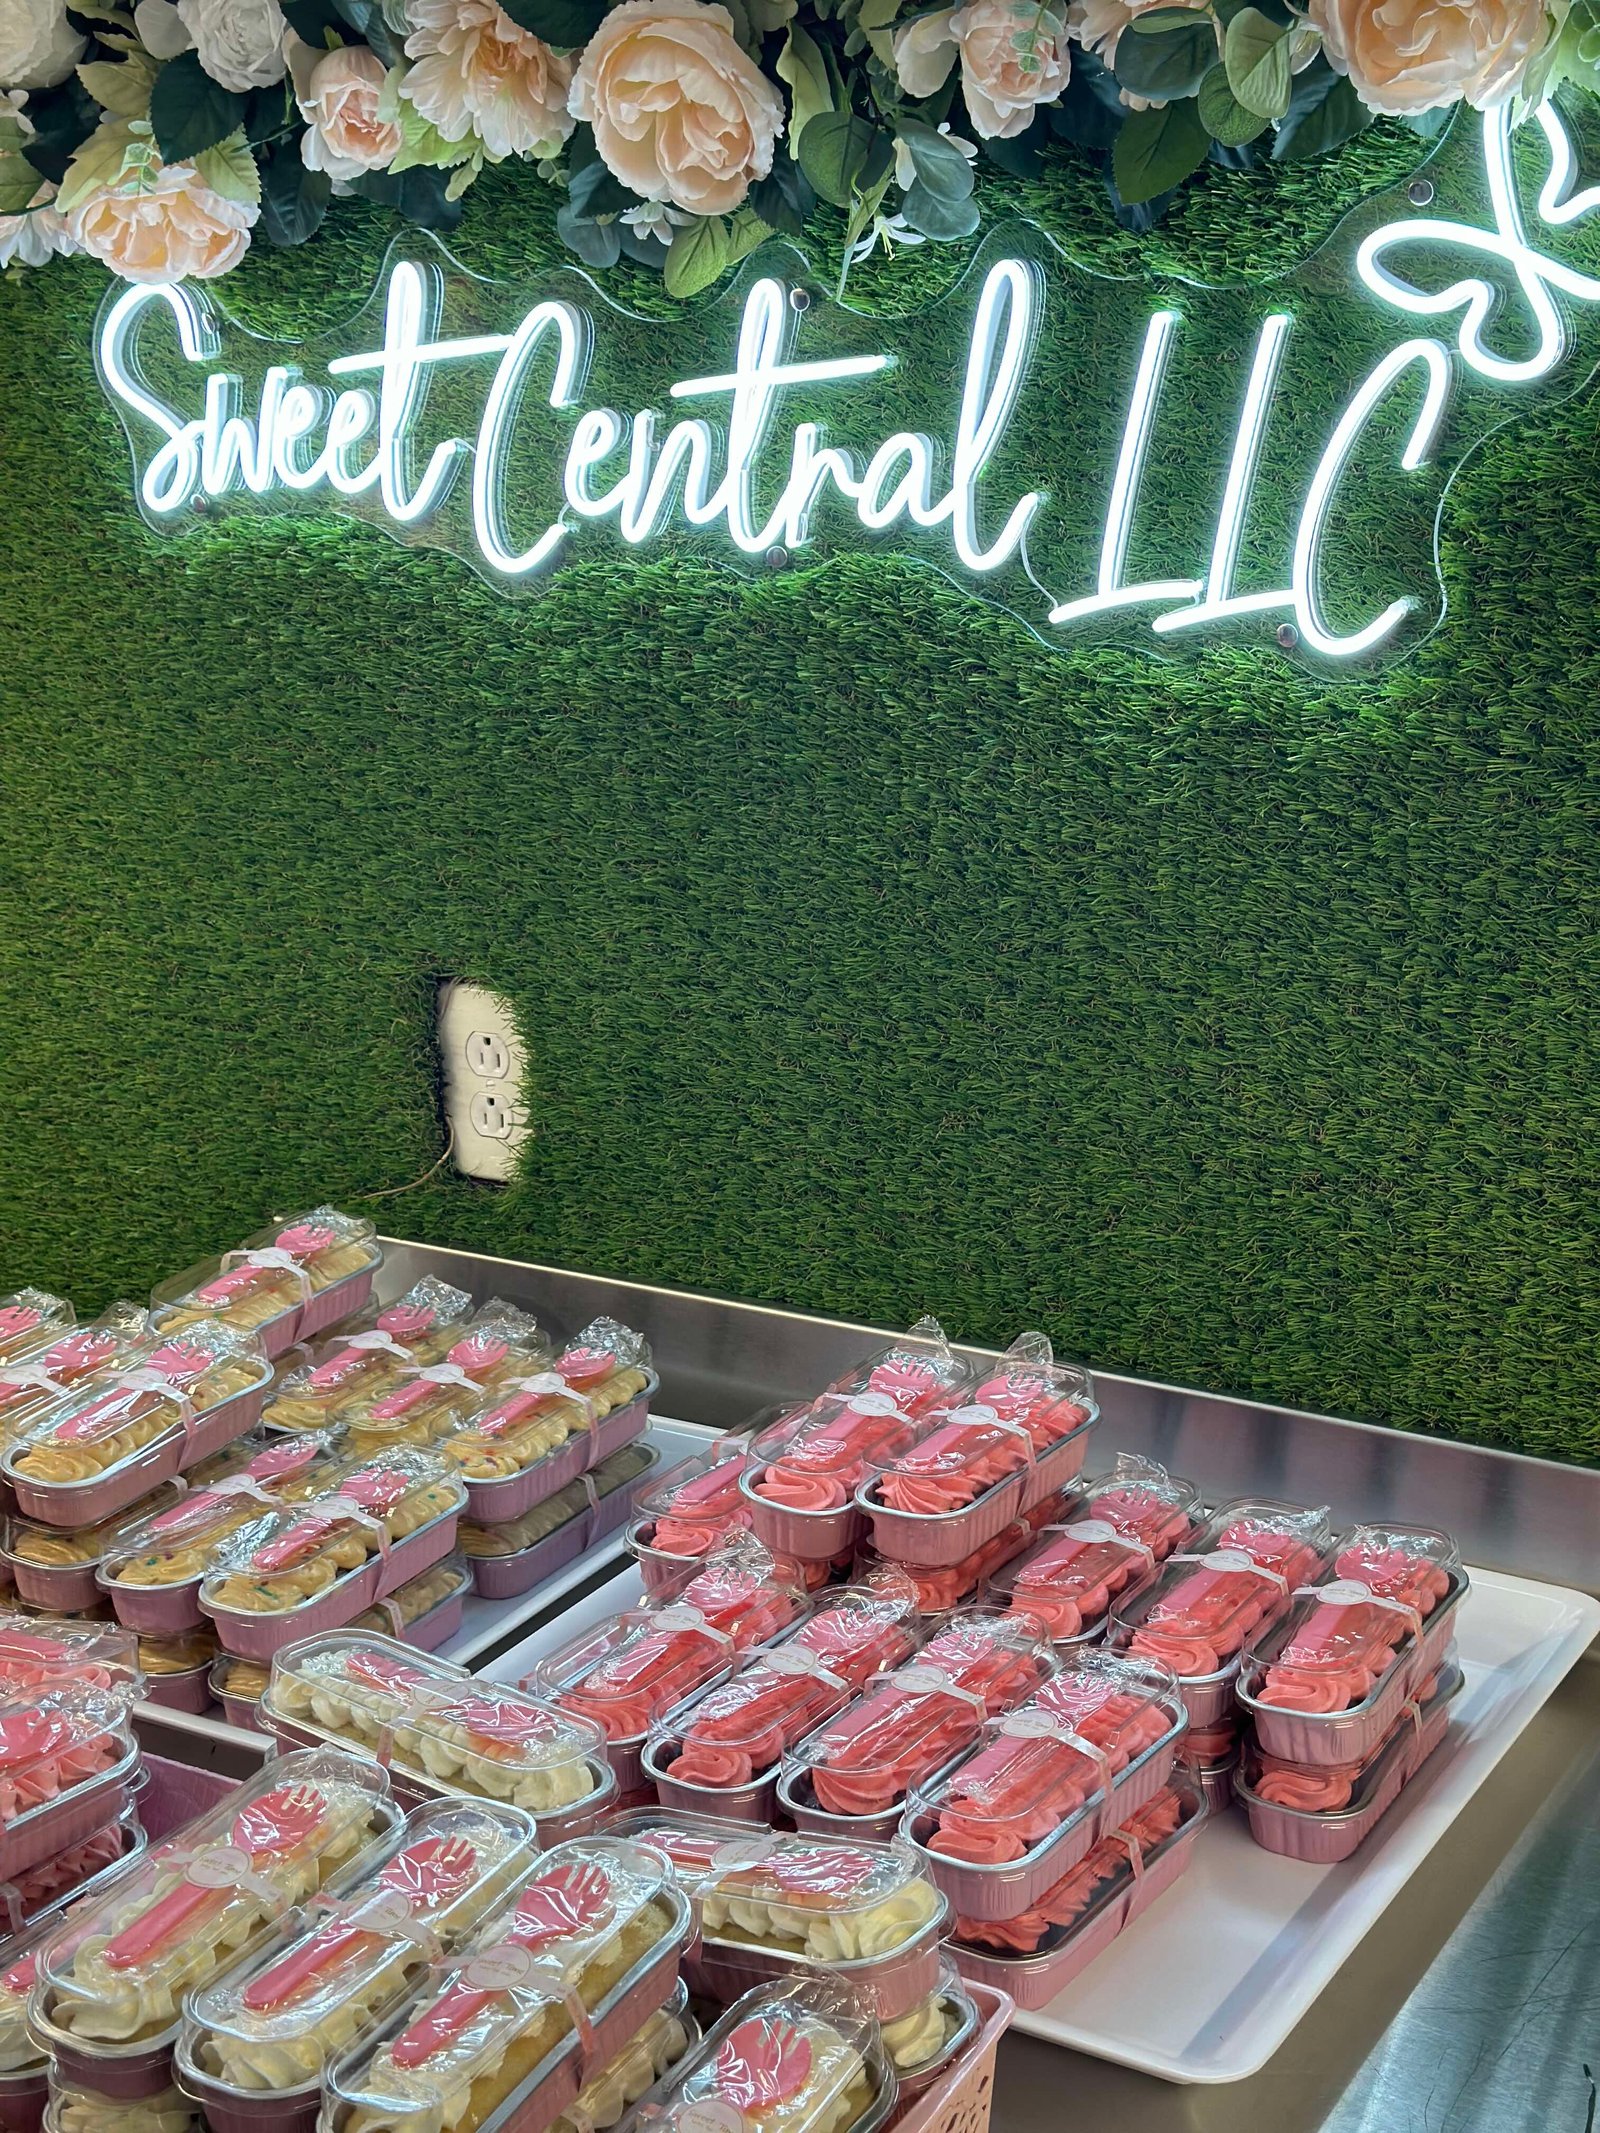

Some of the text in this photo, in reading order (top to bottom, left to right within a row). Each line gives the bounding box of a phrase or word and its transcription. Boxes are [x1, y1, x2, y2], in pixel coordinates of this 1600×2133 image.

[99, 259, 1450, 656] Sweet Central LLC
